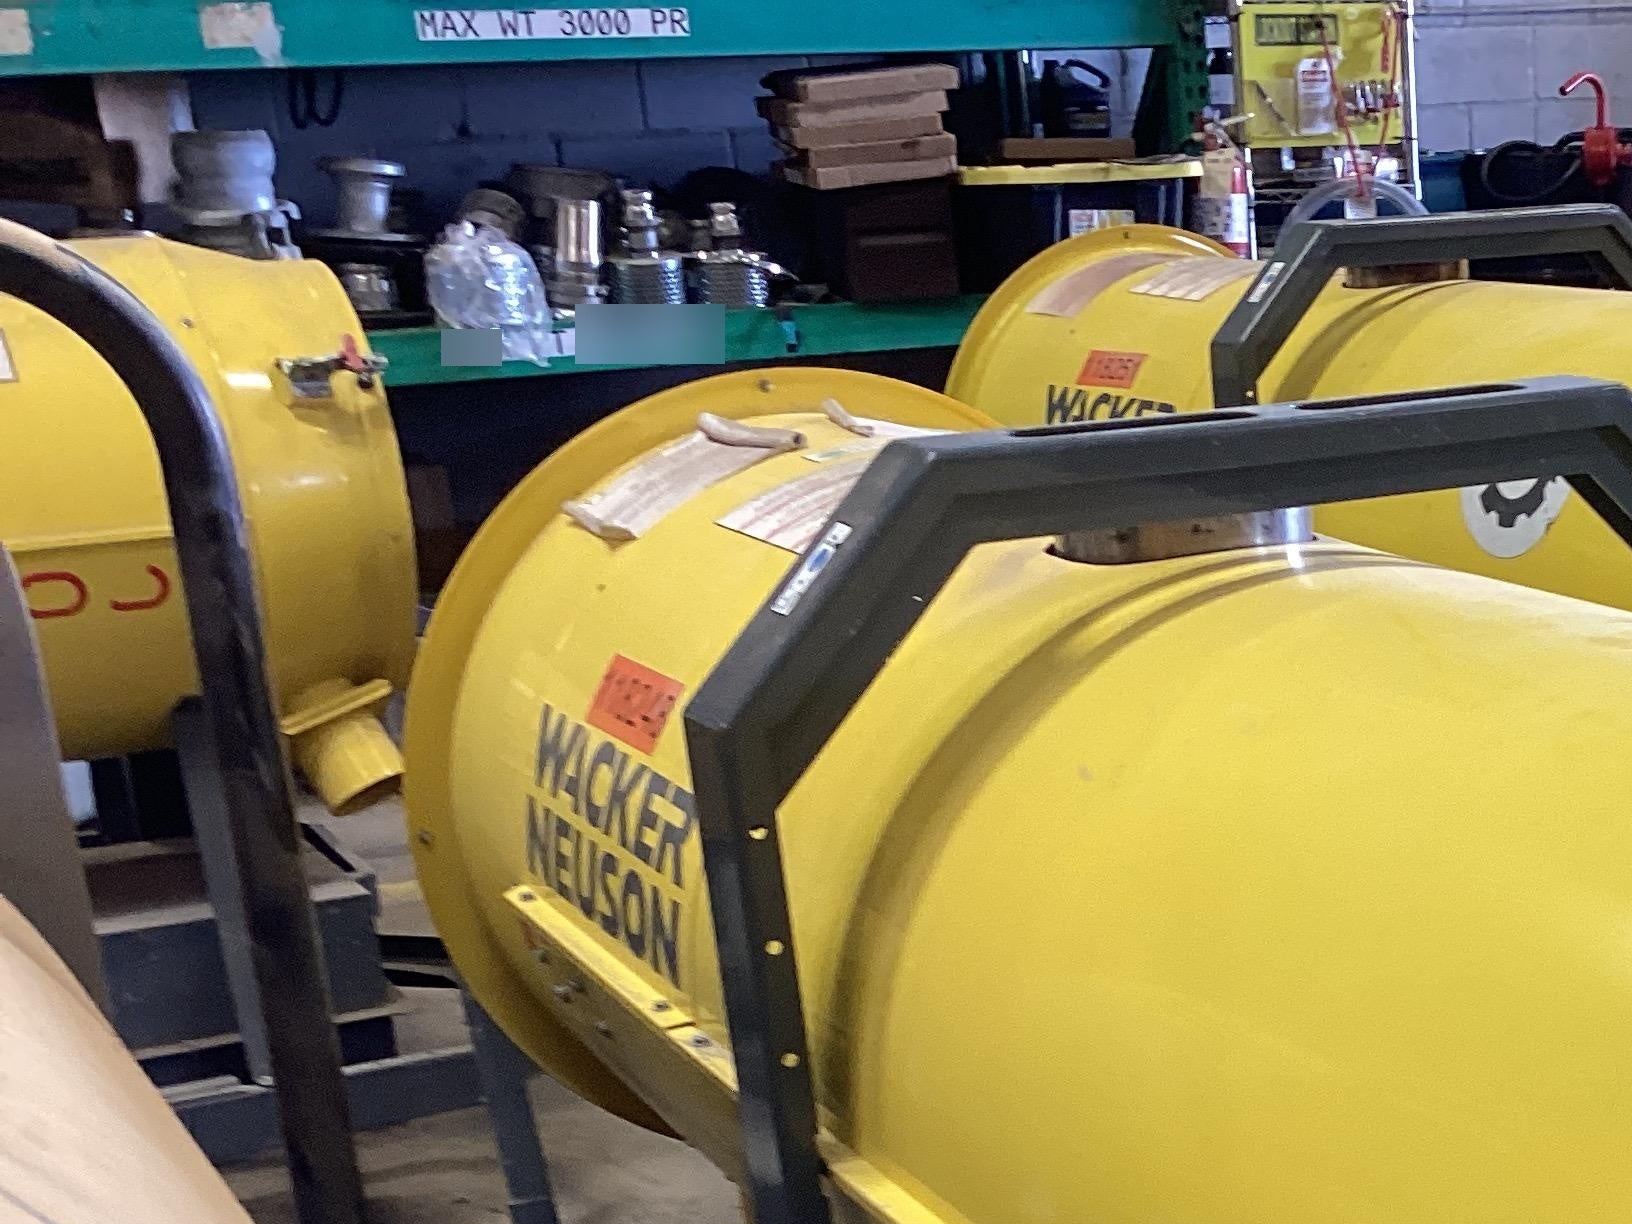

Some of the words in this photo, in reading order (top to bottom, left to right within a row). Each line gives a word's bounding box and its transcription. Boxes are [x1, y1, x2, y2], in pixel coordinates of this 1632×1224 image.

[420, 11, 480, 38] MAX
[498, 11, 535, 37] WT
[558, 10, 631, 36] 3000
[651, 9, 690, 34] PR
[1047, 384, 1176, 425] WACK
[535, 702, 698, 889] WACKER
[526, 793, 682, 990] NEUSON
